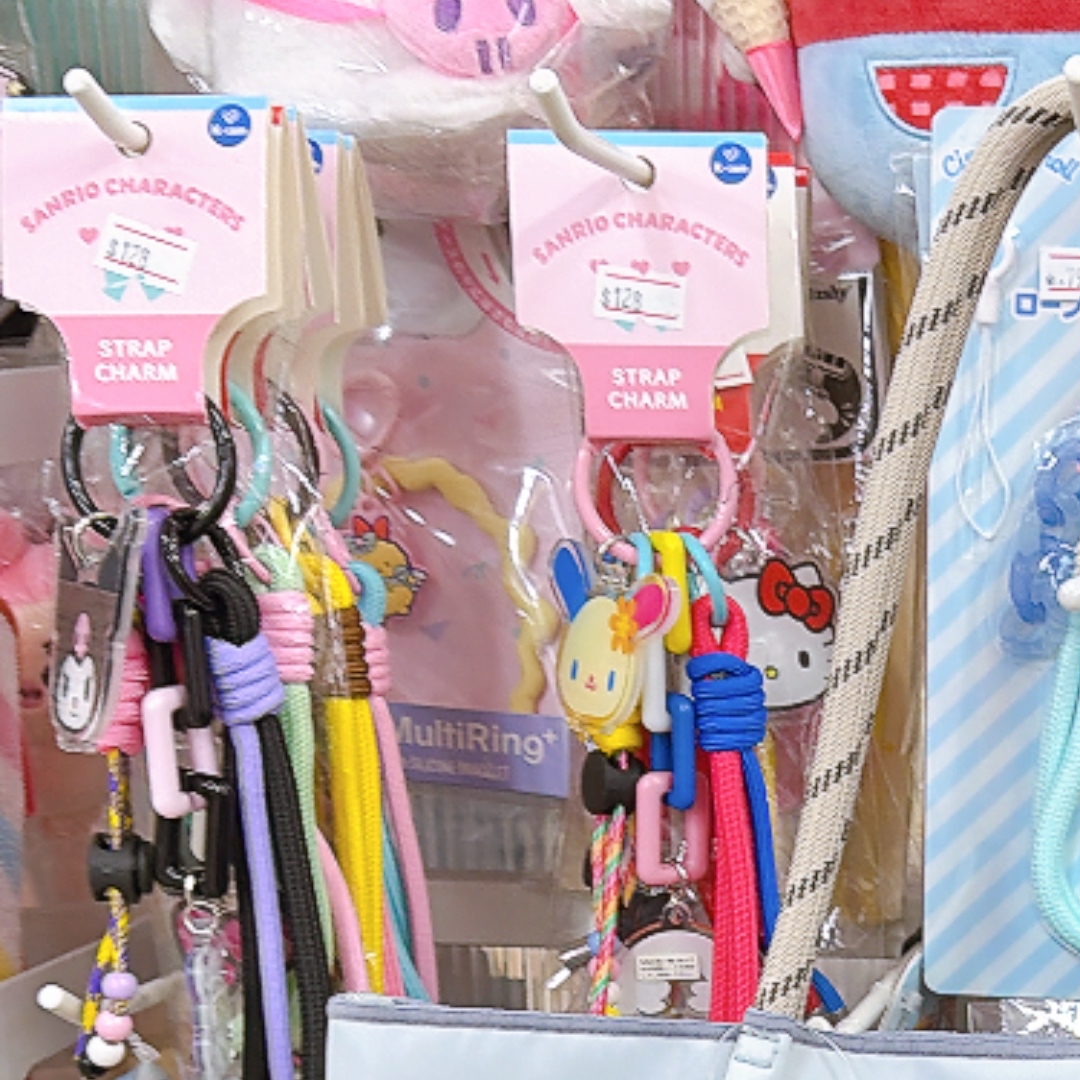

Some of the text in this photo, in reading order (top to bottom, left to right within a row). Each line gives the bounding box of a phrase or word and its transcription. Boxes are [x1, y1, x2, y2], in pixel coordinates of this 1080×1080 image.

[20, 177, 246, 234] SANRIO CHARACTERS
[532, 211, 750, 270] SANRIO CHARACTERS
[98, 338, 173, 358] STRAP
[93, 363, 178, 382] CHARM
[611, 367, 682, 387] STRAP
[607, 392, 689, 410] CHARM
